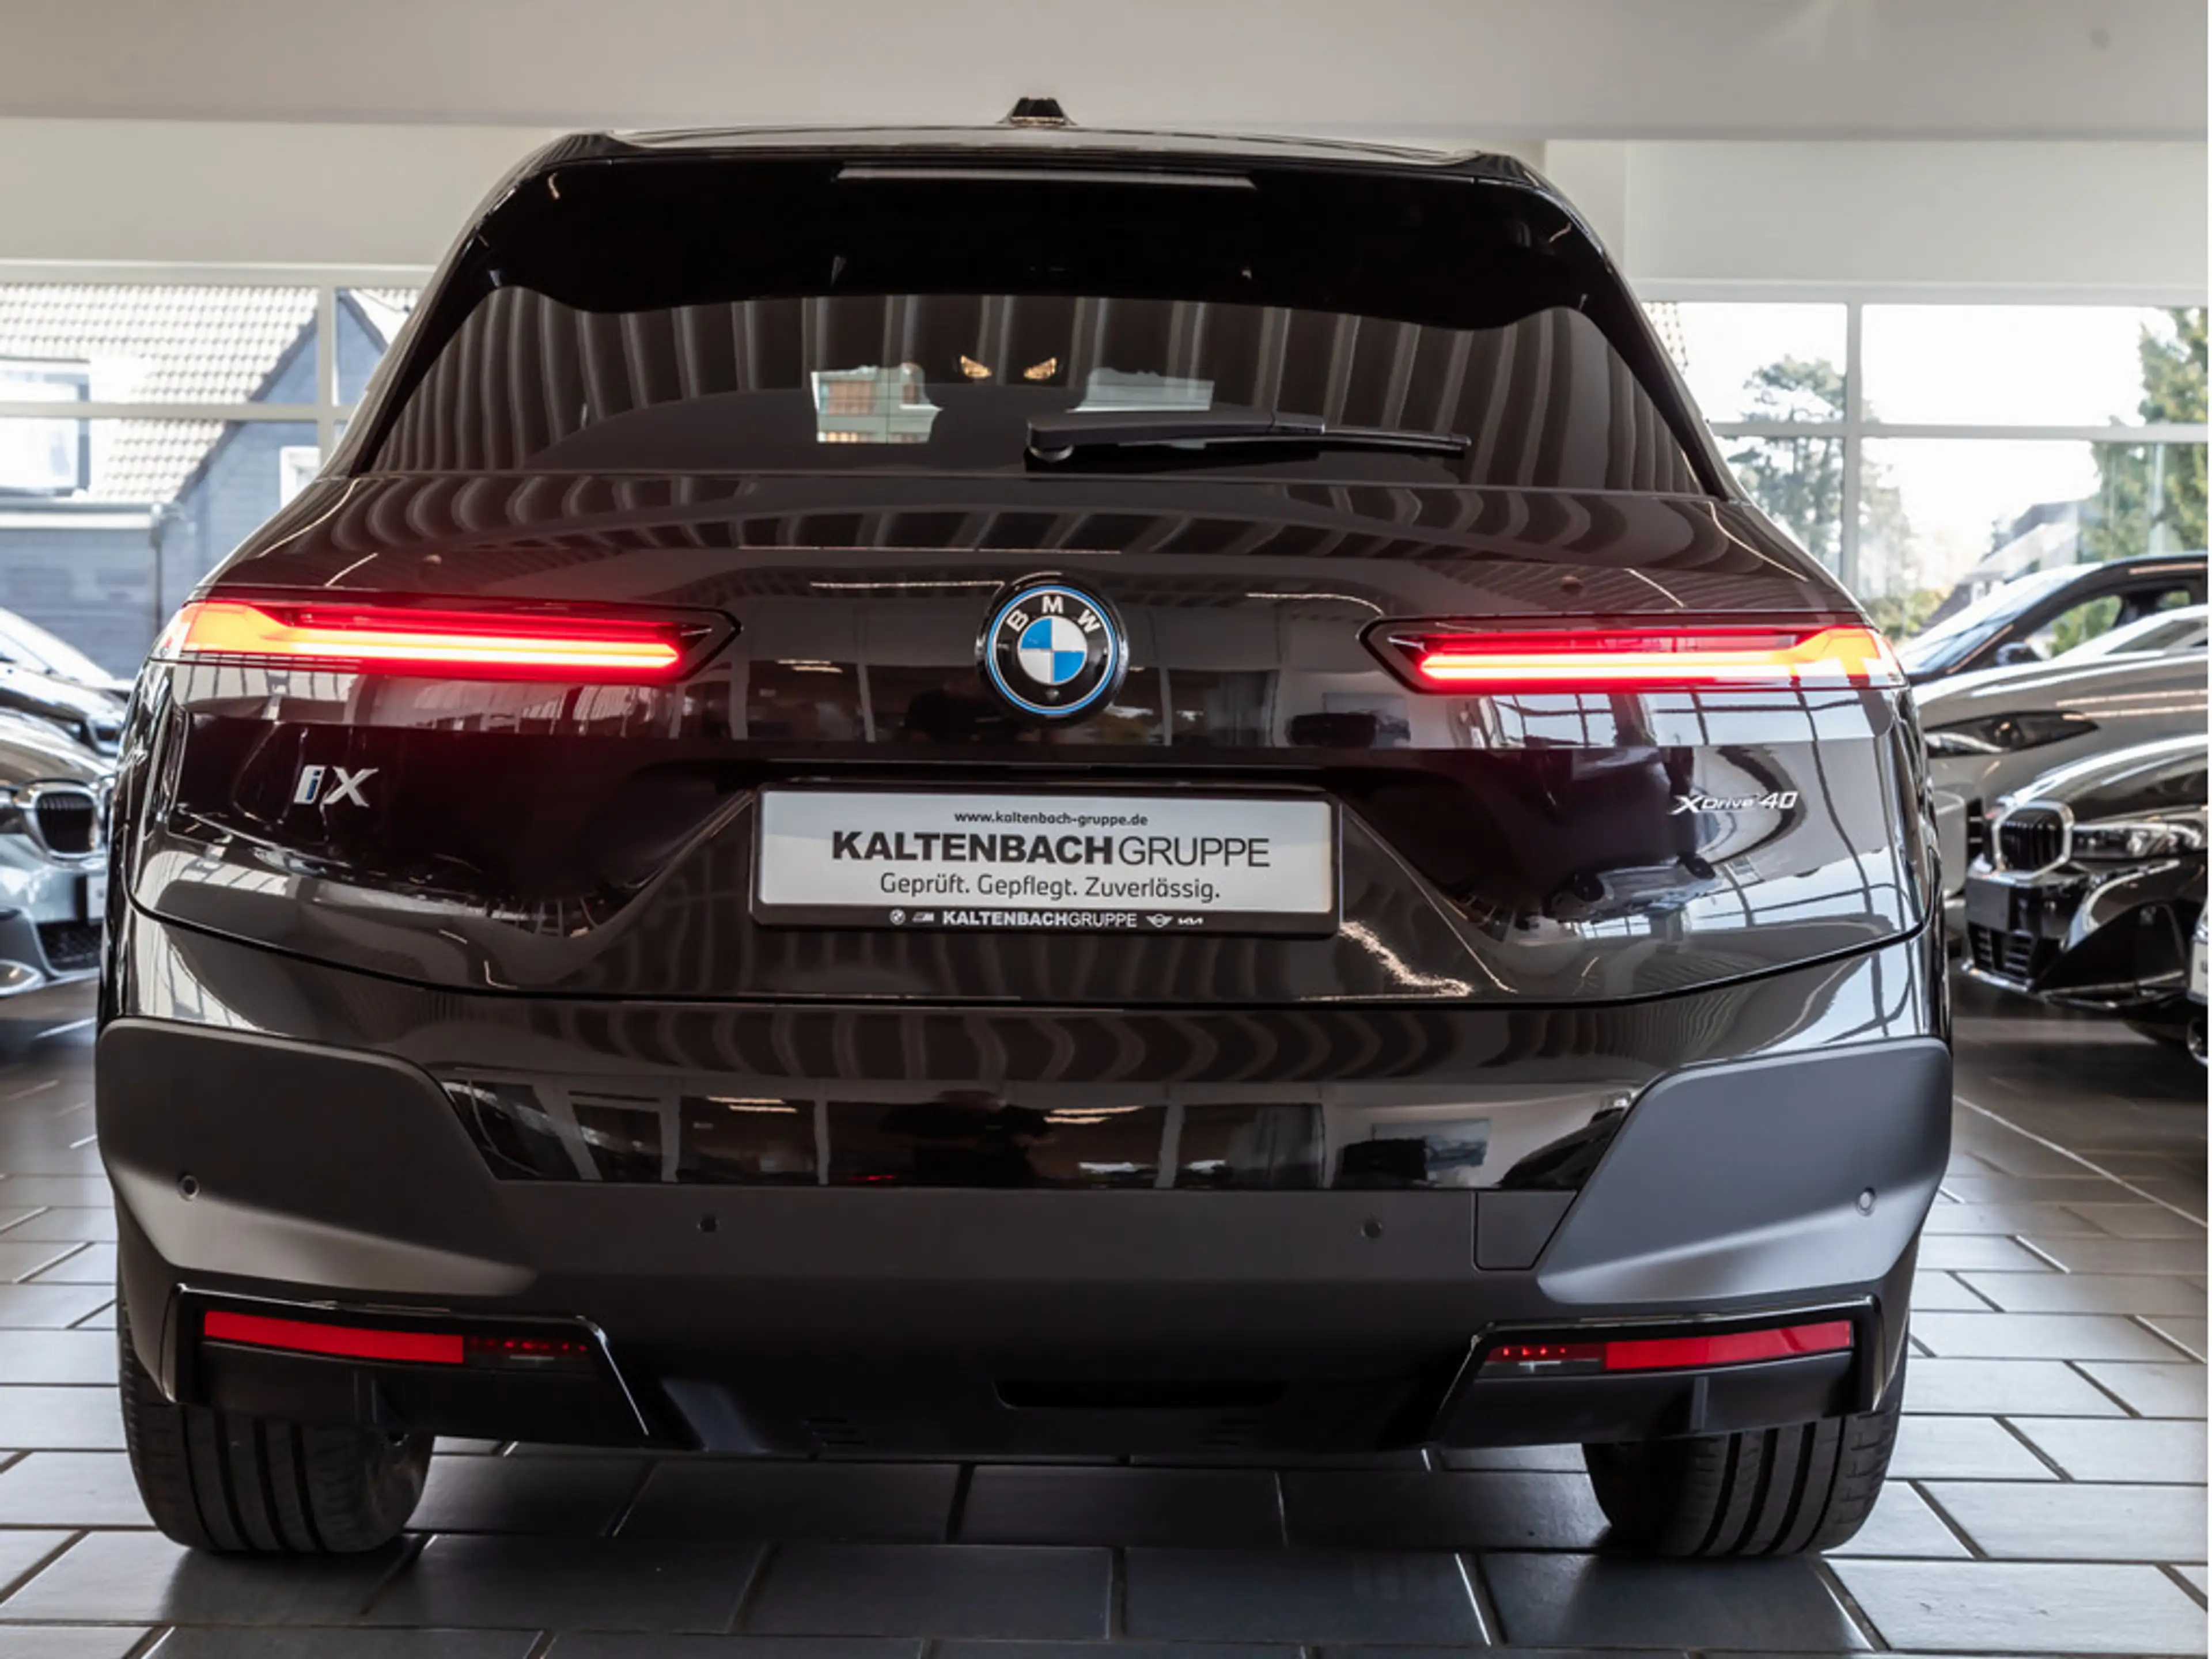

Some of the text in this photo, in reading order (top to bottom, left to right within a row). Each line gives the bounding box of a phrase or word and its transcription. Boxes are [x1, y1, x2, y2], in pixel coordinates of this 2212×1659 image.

[1006, 596, 1101, 633] BMW
[1758, 790, 1799, 809] 40
[954, 811, 1148, 828] www.kaltenbach-gruppe.de
[880, 872, 1220, 904] Geprüft. Gepflegt. Zuverlässig.
